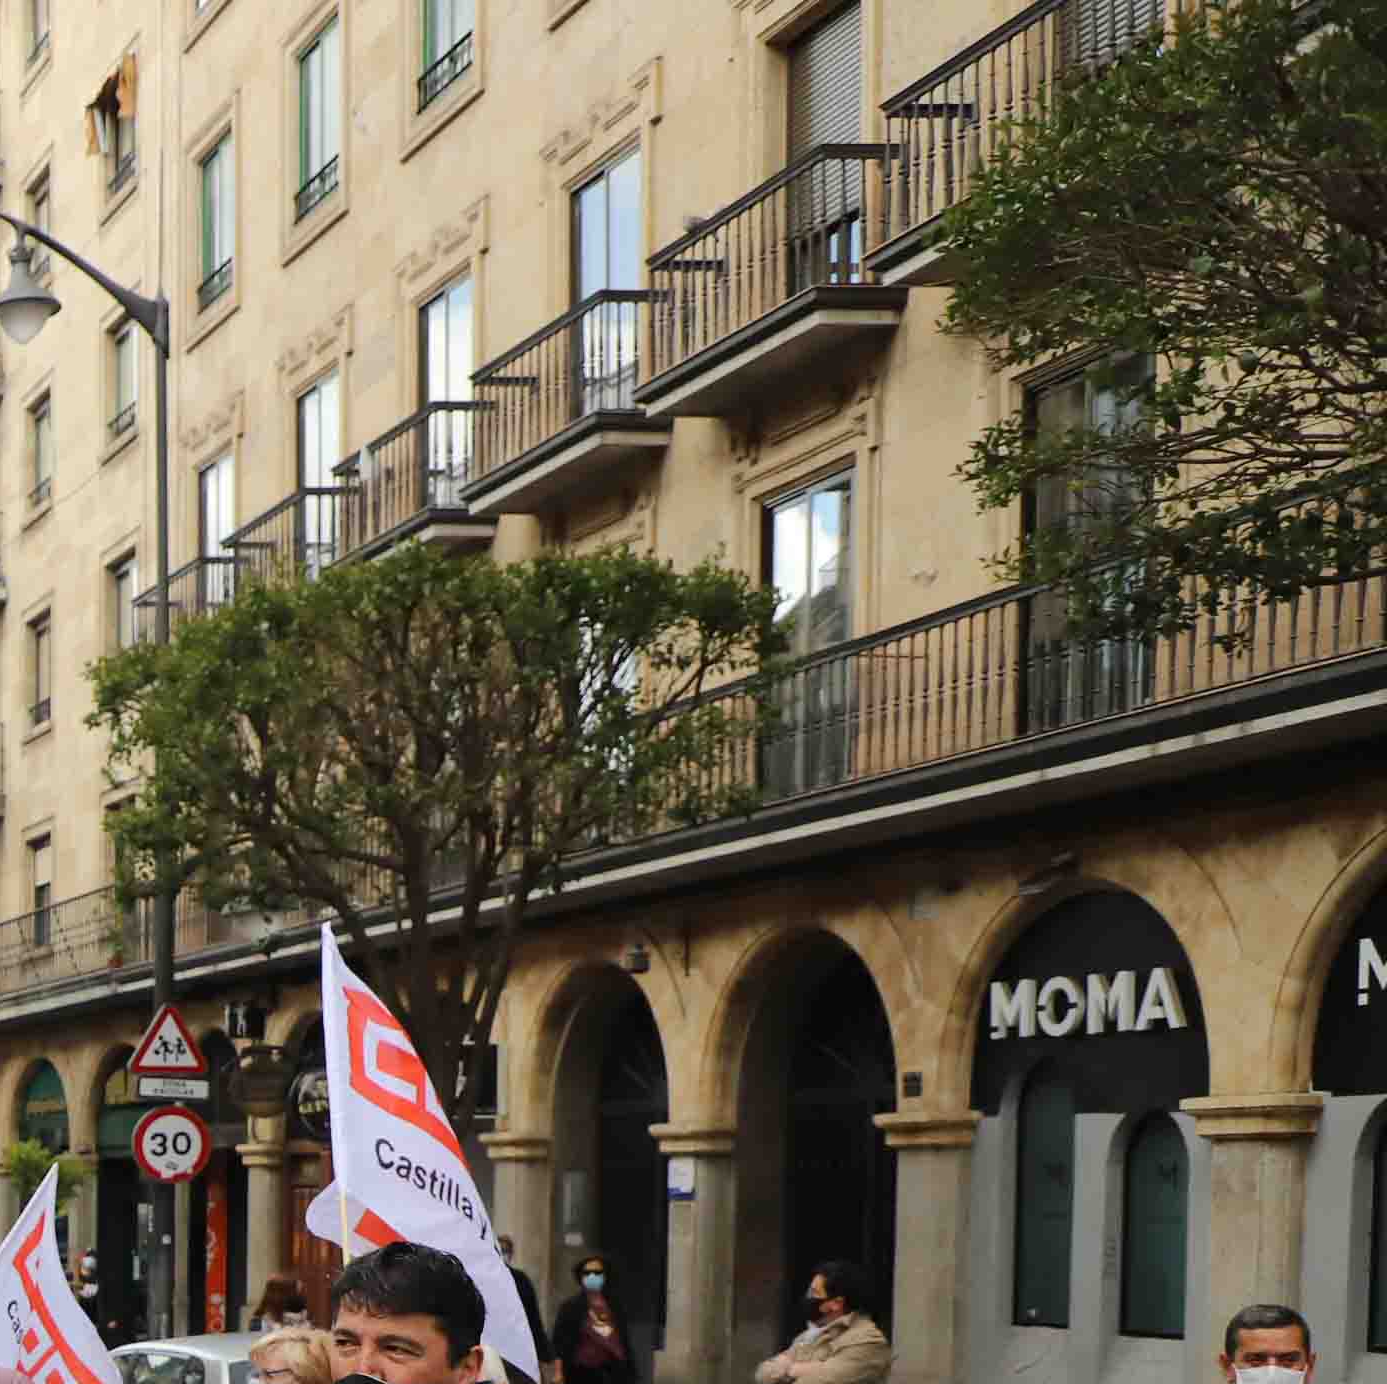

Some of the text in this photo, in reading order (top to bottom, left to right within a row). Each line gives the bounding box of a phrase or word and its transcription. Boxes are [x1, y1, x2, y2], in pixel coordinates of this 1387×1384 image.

[989, 967, 1187, 1040] MOMA
[150, 1132, 192, 1157] 30
[374, 1137, 475, 1220] Castilla
